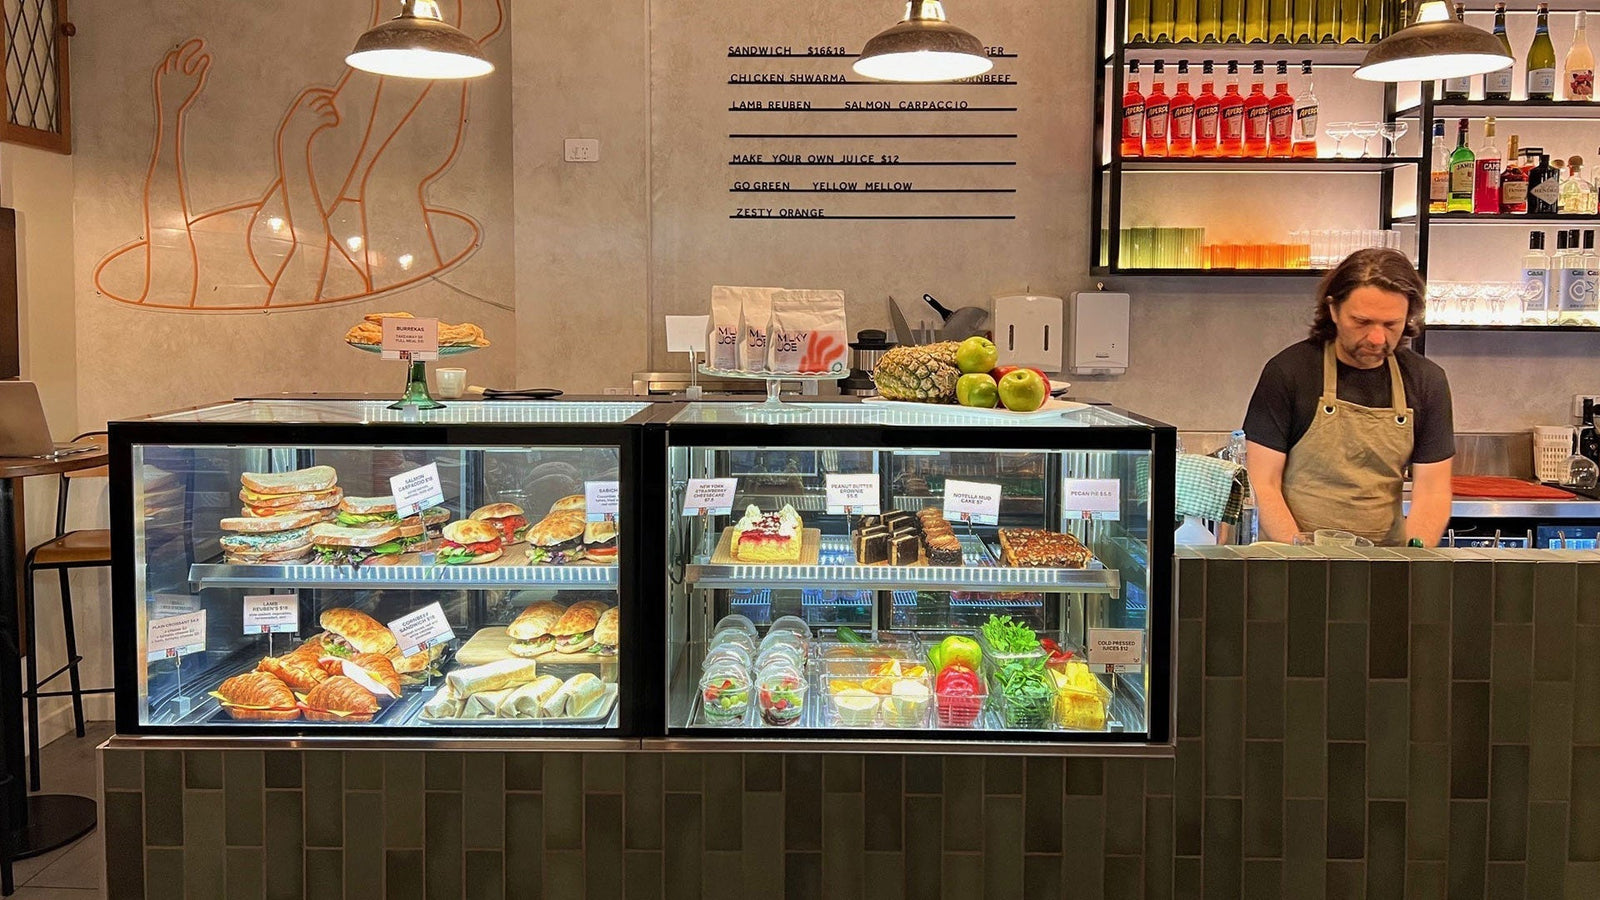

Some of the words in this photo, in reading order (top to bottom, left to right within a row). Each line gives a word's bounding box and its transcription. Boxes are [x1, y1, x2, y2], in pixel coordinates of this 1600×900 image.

[728, 46, 792, 56] SANDWICH
[807, 46, 846, 56] $16&18
[730, 74, 785, 83] CHICKEN
[789, 74, 847, 83] SHWARMA
[732, 101, 762, 110] LAMB
[768, 101, 811, 110] REUBEN
[844, 101, 891, 110] SALMON
[898, 101, 968, 110] CARPACCIO
[1174, 106, 1193, 117] APERO
[1225, 106, 1243, 117] APERO
[1300, 106, 1318, 117] APERO
[732, 154, 763, 164] MAKE
[772, 154, 802, 164] YOUR
[807, 154, 834, 164] OWN
[839, 154, 875, 164] JUICE
[881, 154, 900, 164] $12
[733, 182, 750, 191] GO
[753, 182, 790, 191] GREEN
[812, 182, 858, 191] YELLOW
[864, 182, 913, 191] MELLOW
[736, 208, 773, 218] ZESTY
[779, 208, 825, 218] ORANGE
[777, 333, 808, 342] MLKY
[777, 342, 798, 352] JOE
[404, 474, 425, 484] SALMON
[166, 620, 190, 628] CROISSANT
[401, 612, 429, 627] CORNBEEF
[399, 618, 427, 633] SANDWICH
